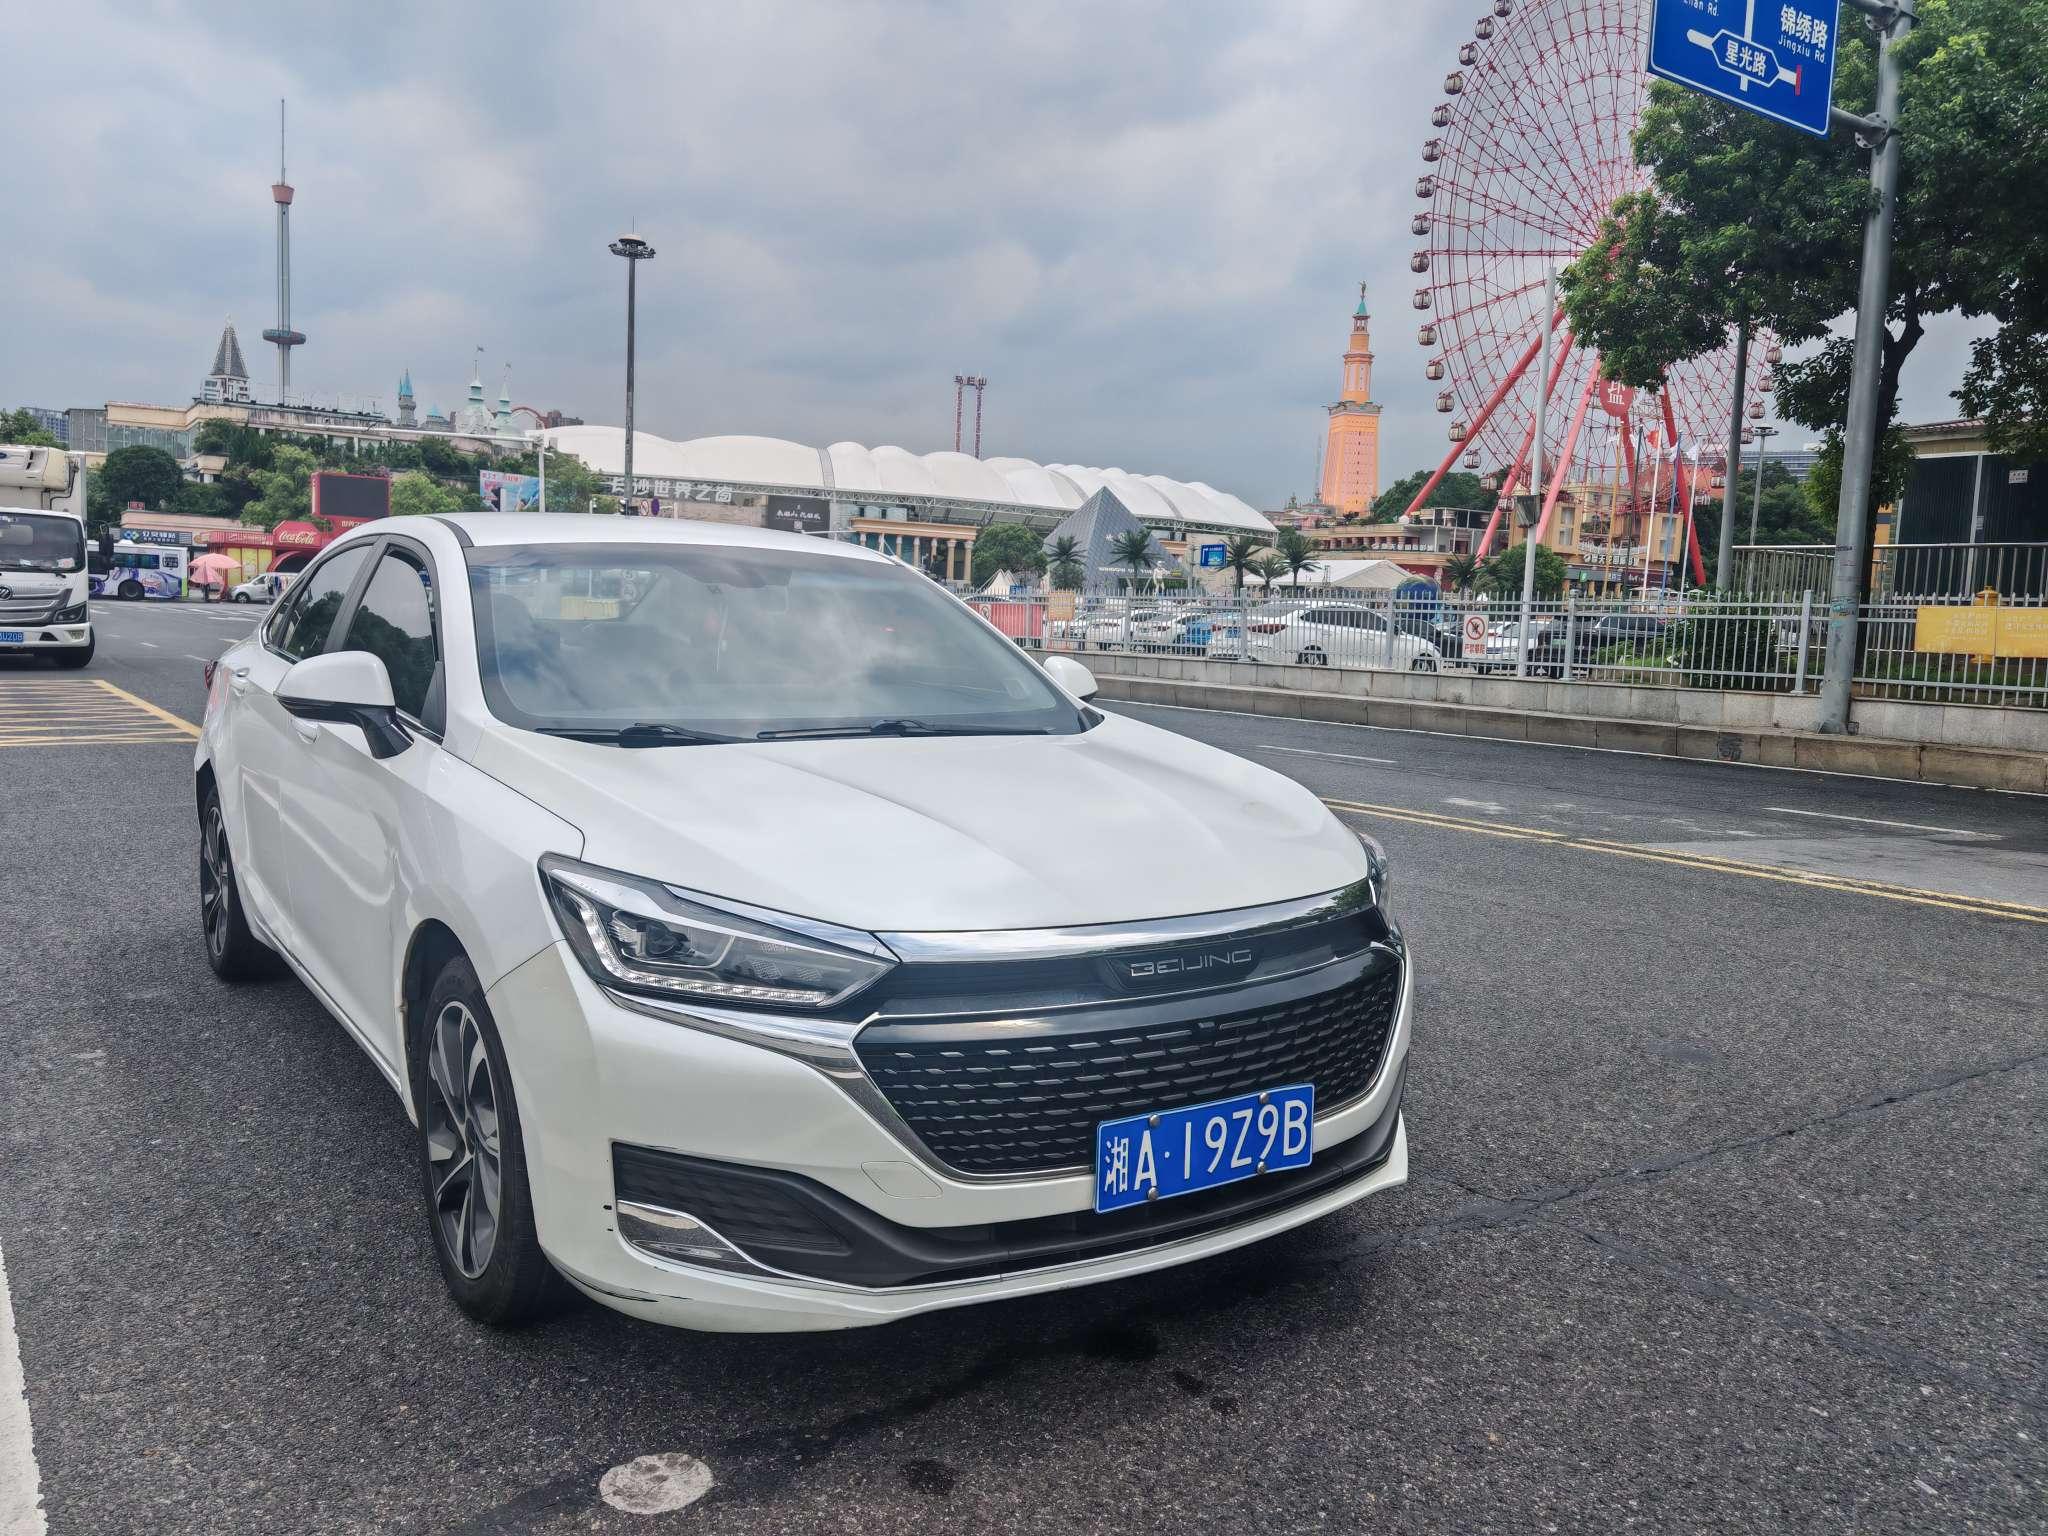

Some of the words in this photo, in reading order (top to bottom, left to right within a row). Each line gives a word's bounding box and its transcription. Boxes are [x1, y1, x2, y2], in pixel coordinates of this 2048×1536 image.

[1781, 3, 1828, 50] 锦绣路
[1725, 40, 1767, 78] 星光路
[1778, 35, 1810, 57] Jingxiu
[611, 477, 733, 503] 长沙世界之窗
[1130, 949, 1253, 977] BEIJING
